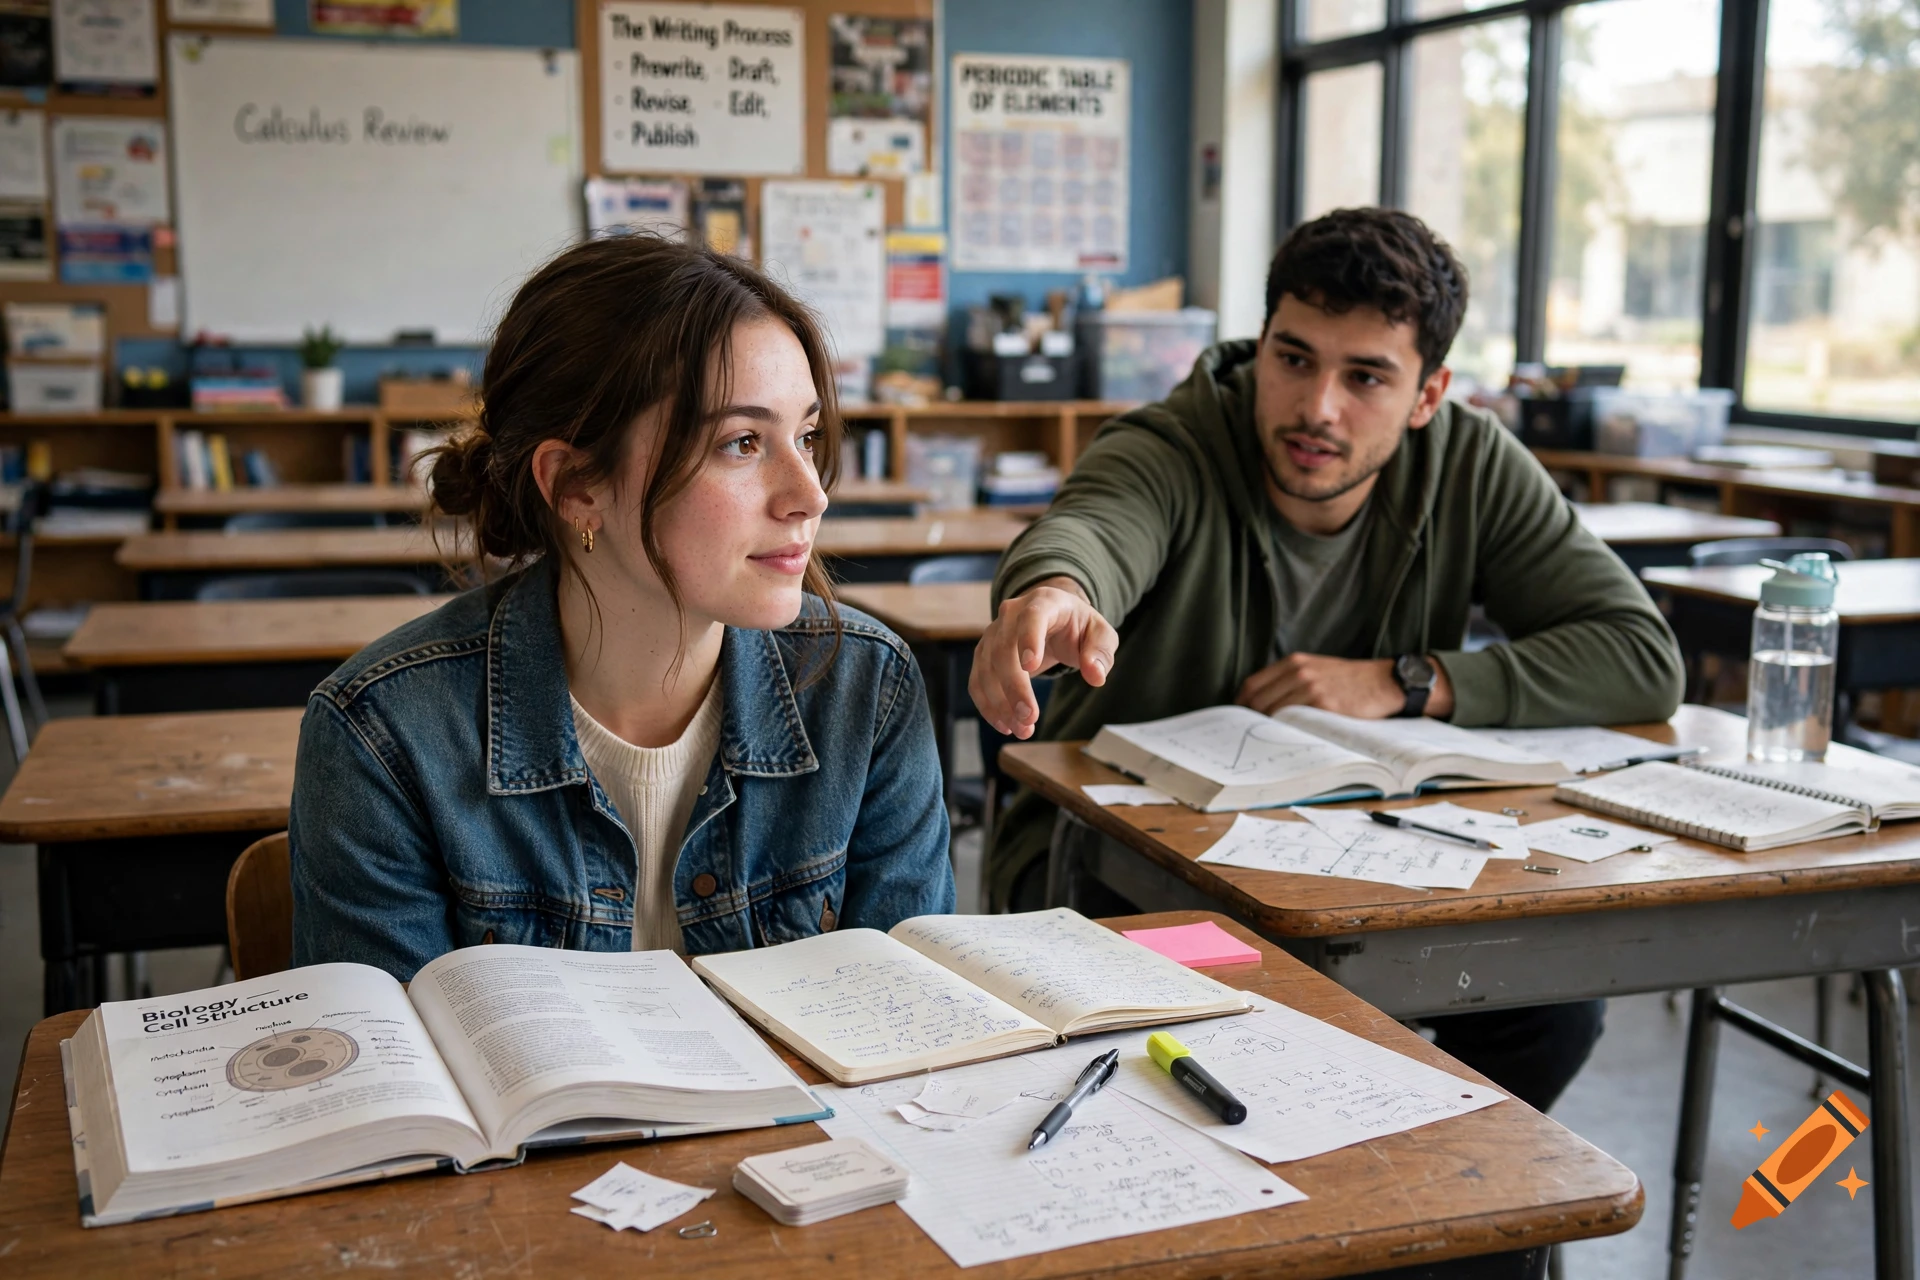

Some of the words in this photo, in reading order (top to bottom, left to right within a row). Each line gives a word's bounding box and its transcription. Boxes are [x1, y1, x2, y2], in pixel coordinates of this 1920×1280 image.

[610, 14, 646, 41] The
[649, 16, 720, 50] Writing
[724, 19, 793, 47] Process
[631, 52, 708, 82] Prewrite,
[728, 56, 779, 86] Draft,
[961, 64, 1049, 88] PERIODIC
[1059, 68, 1115, 90] TABLE
[728, 90, 770, 120] Edit,
[970, 91, 995, 114] OF
[1003, 92, 1103, 117] ELEMENTS
[233, 101, 351, 145] Calculus
[362, 104, 453, 146] Review
[631, 121, 698, 147] Publish
[142, 998, 238, 1023] Biology
[143, 1017, 188, 1033] Cell
[196, 992, 309, 1025] Structure
